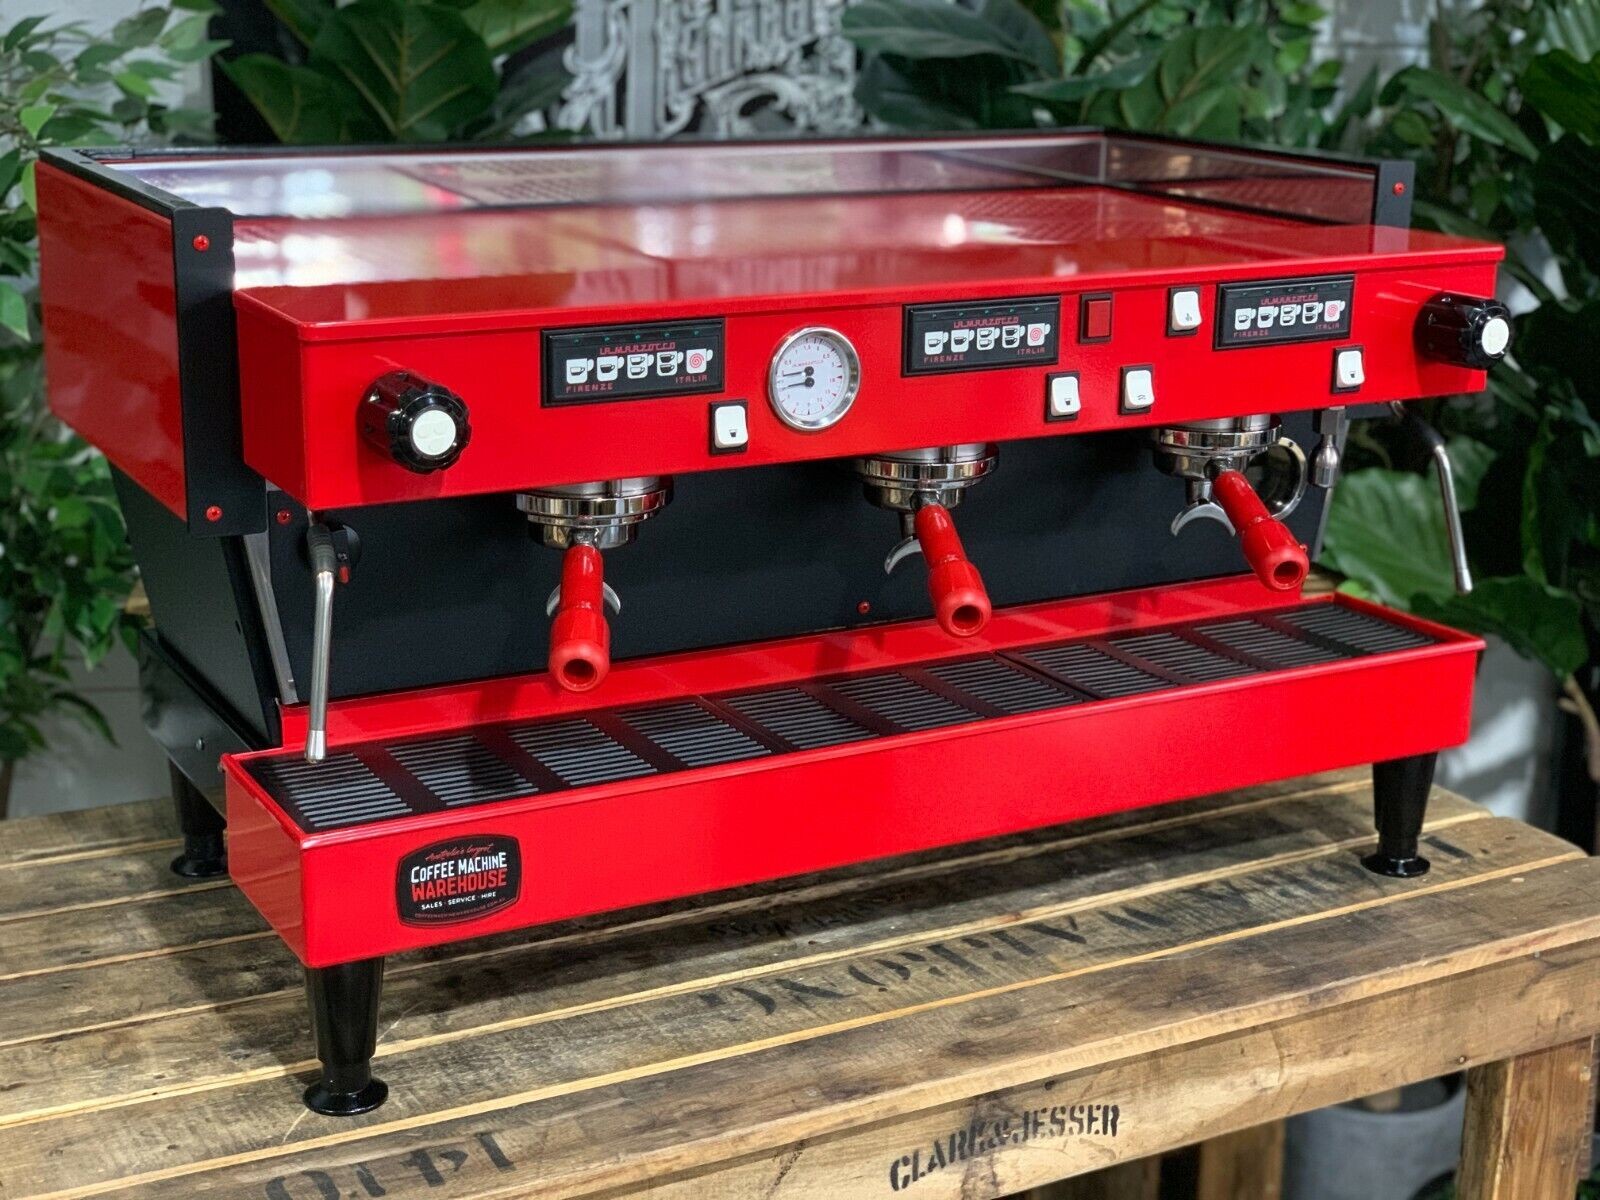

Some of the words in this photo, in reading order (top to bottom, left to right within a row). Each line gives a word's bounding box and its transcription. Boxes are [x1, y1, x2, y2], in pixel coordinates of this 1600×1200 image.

[1233, 330, 1269, 338] FIRENZE
[614, 342, 676, 353] MARZOCCO
[1017, 347, 1046, 355] ITALIA
[923, 354, 965, 363] FIRENZE
[675, 375, 708, 384] ITALIA
[565, 383, 614, 393] FIRENZE
[410, 861, 455, 883] COFFEE
[458, 852, 507, 875] MACHINE
[411, 868, 508, 902] WAREHOUSE
[421, 901, 443, 910] SALES
[448, 895, 476, 906] SERVICE
[481, 891, 497, 899] HIRE
